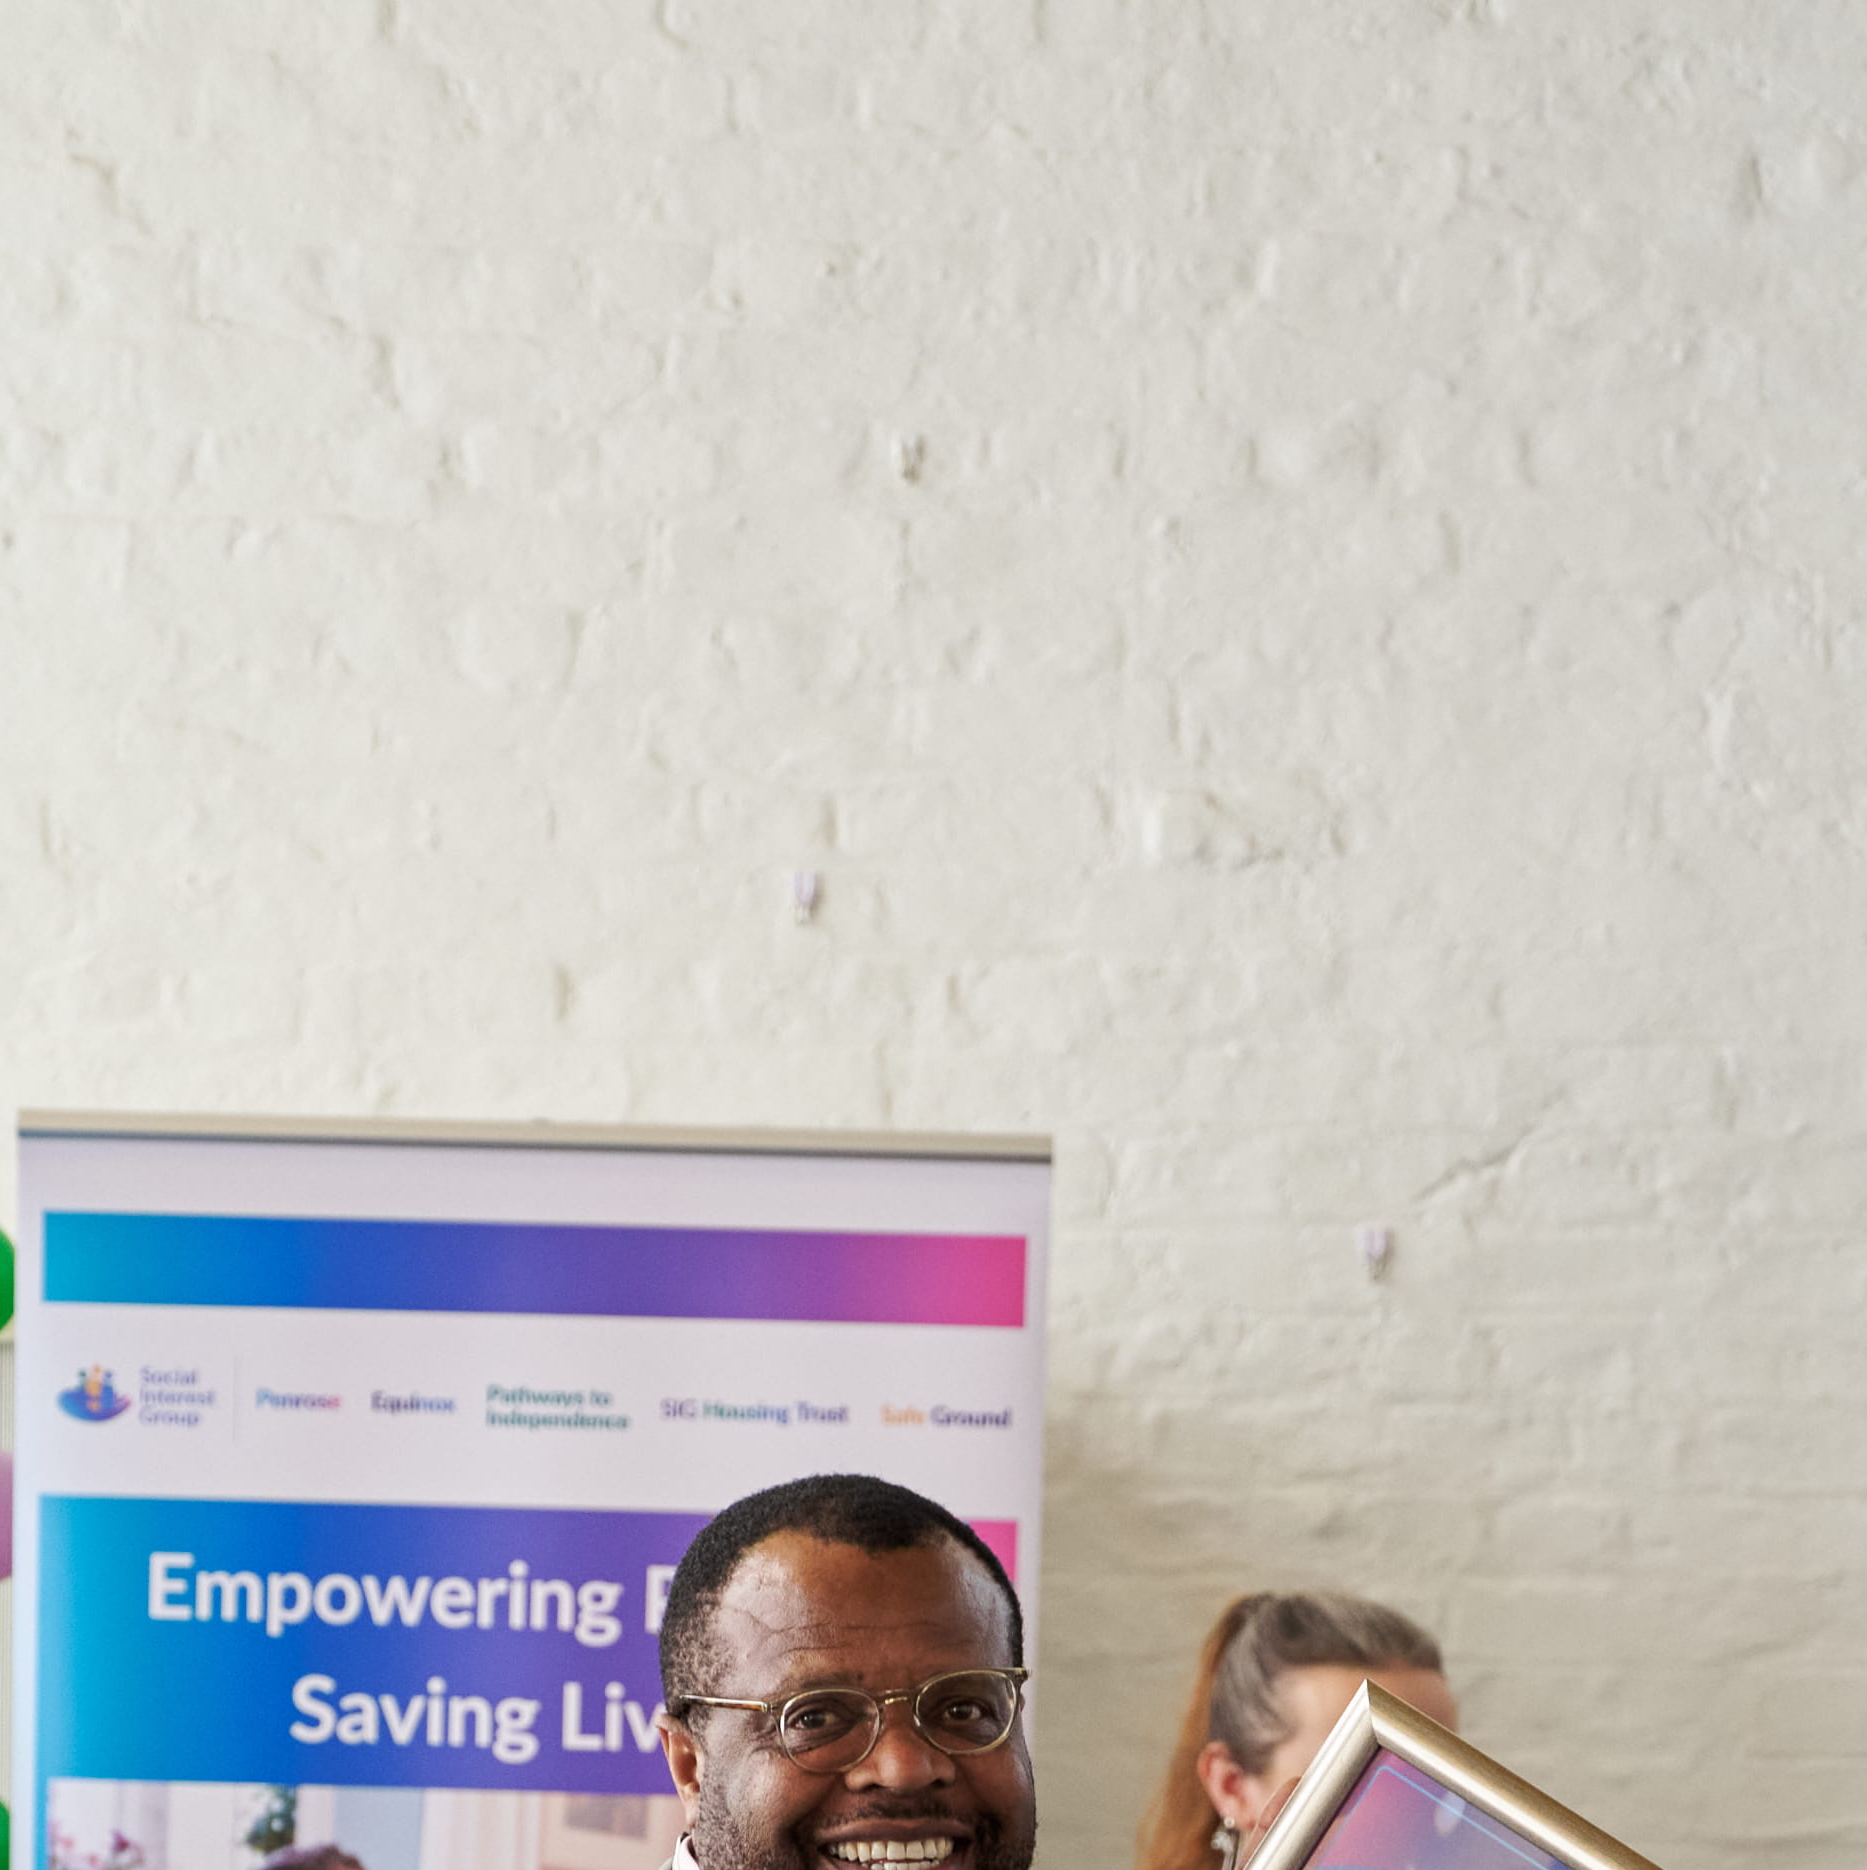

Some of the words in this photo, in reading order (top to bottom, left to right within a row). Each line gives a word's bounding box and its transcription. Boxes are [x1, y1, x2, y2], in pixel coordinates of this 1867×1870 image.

[139, 1366, 197, 1386] Social
[139, 1388, 216, 1407] Interest
[255, 1388, 342, 1411] Penrose
[371, 1390, 456, 1416] Equinox
[486, 1384, 583, 1409] Pathways
[589, 1387, 613, 1407] to
[139, 1409, 200, 1429] Group
[486, 1408, 630, 1432] Independence
[661, 1398, 697, 1421] SIG
[703, 1400, 789, 1426] Housing
[796, 1402, 849, 1424] Trust
[881, 1404, 925, 1426] Safe
[931, 1405, 1012, 1429] Ground
[147, 1551, 623, 1647] Empowering
[290, 1674, 541, 1765] Saving
